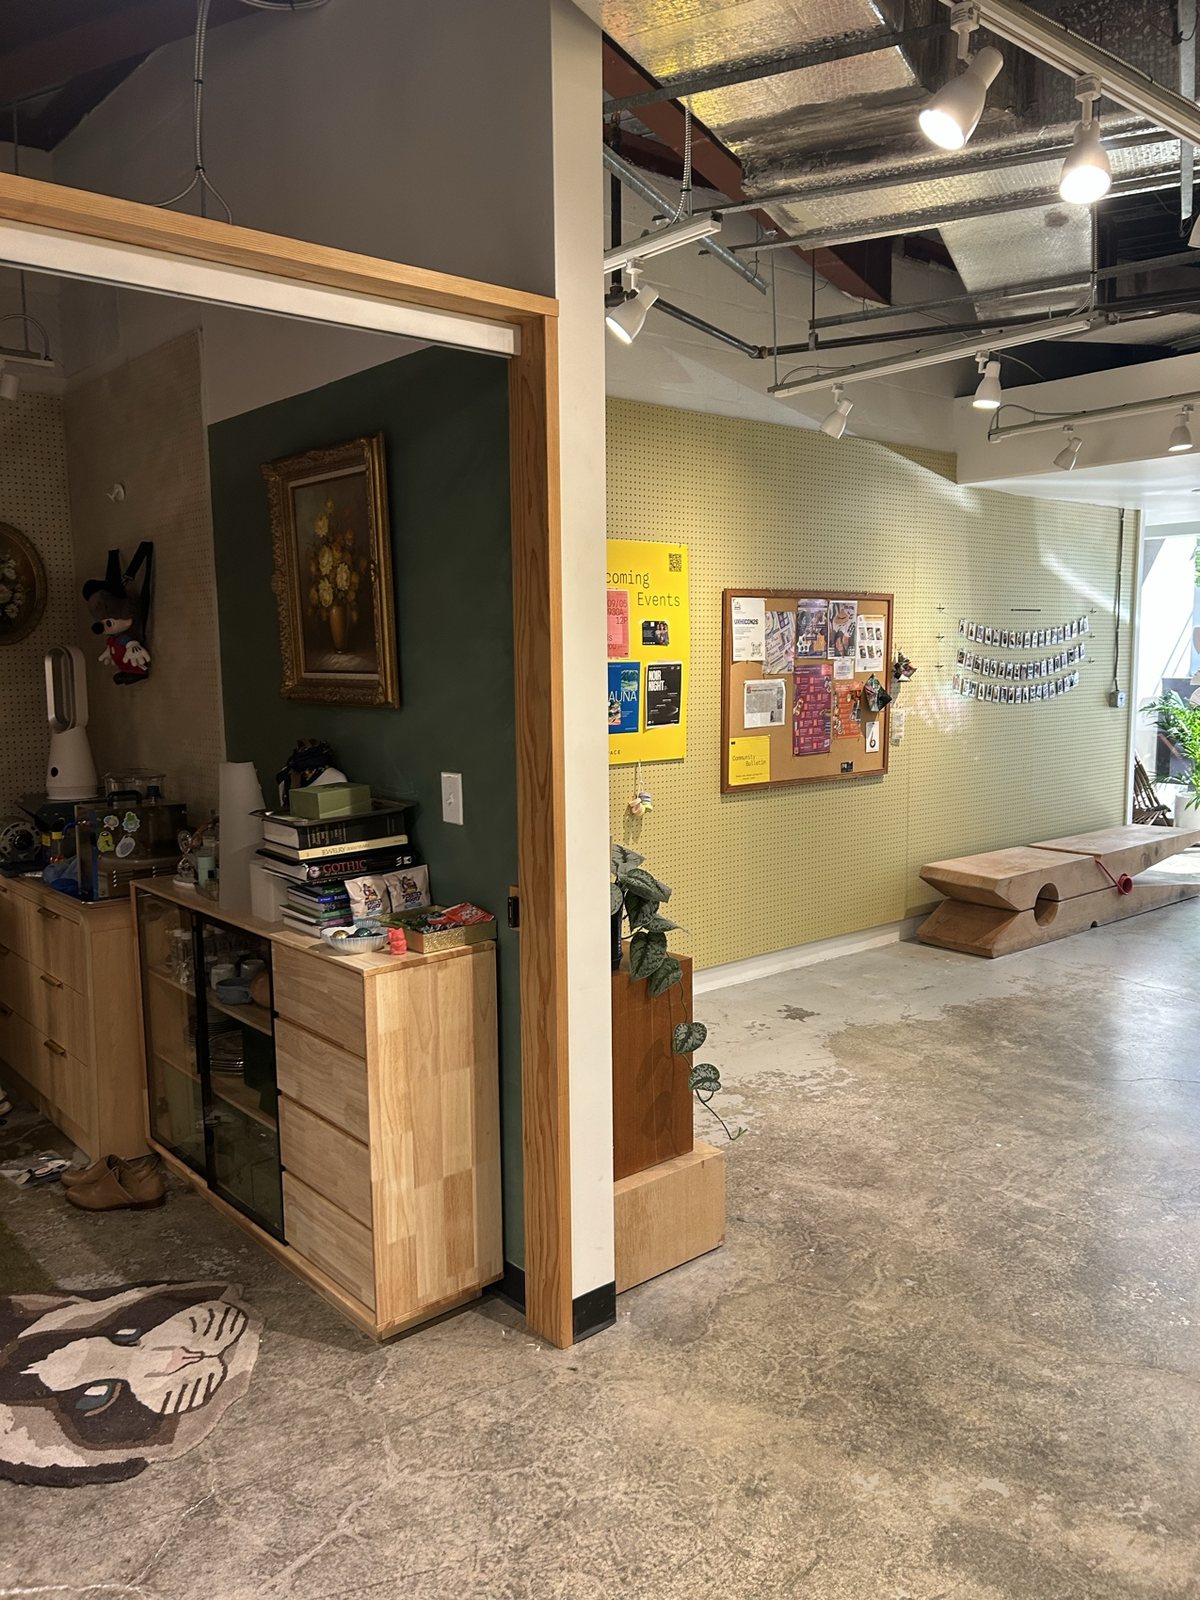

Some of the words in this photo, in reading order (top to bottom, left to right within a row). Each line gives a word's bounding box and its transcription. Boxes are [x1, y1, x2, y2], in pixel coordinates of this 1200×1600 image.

[637, 592, 680, 607] Events
[648, 670, 662, 681] NOIR
[648, 680, 665, 691] NIGHT
[608, 690, 638, 702] AUNA
[323, 860, 367, 874] GOTHIC
